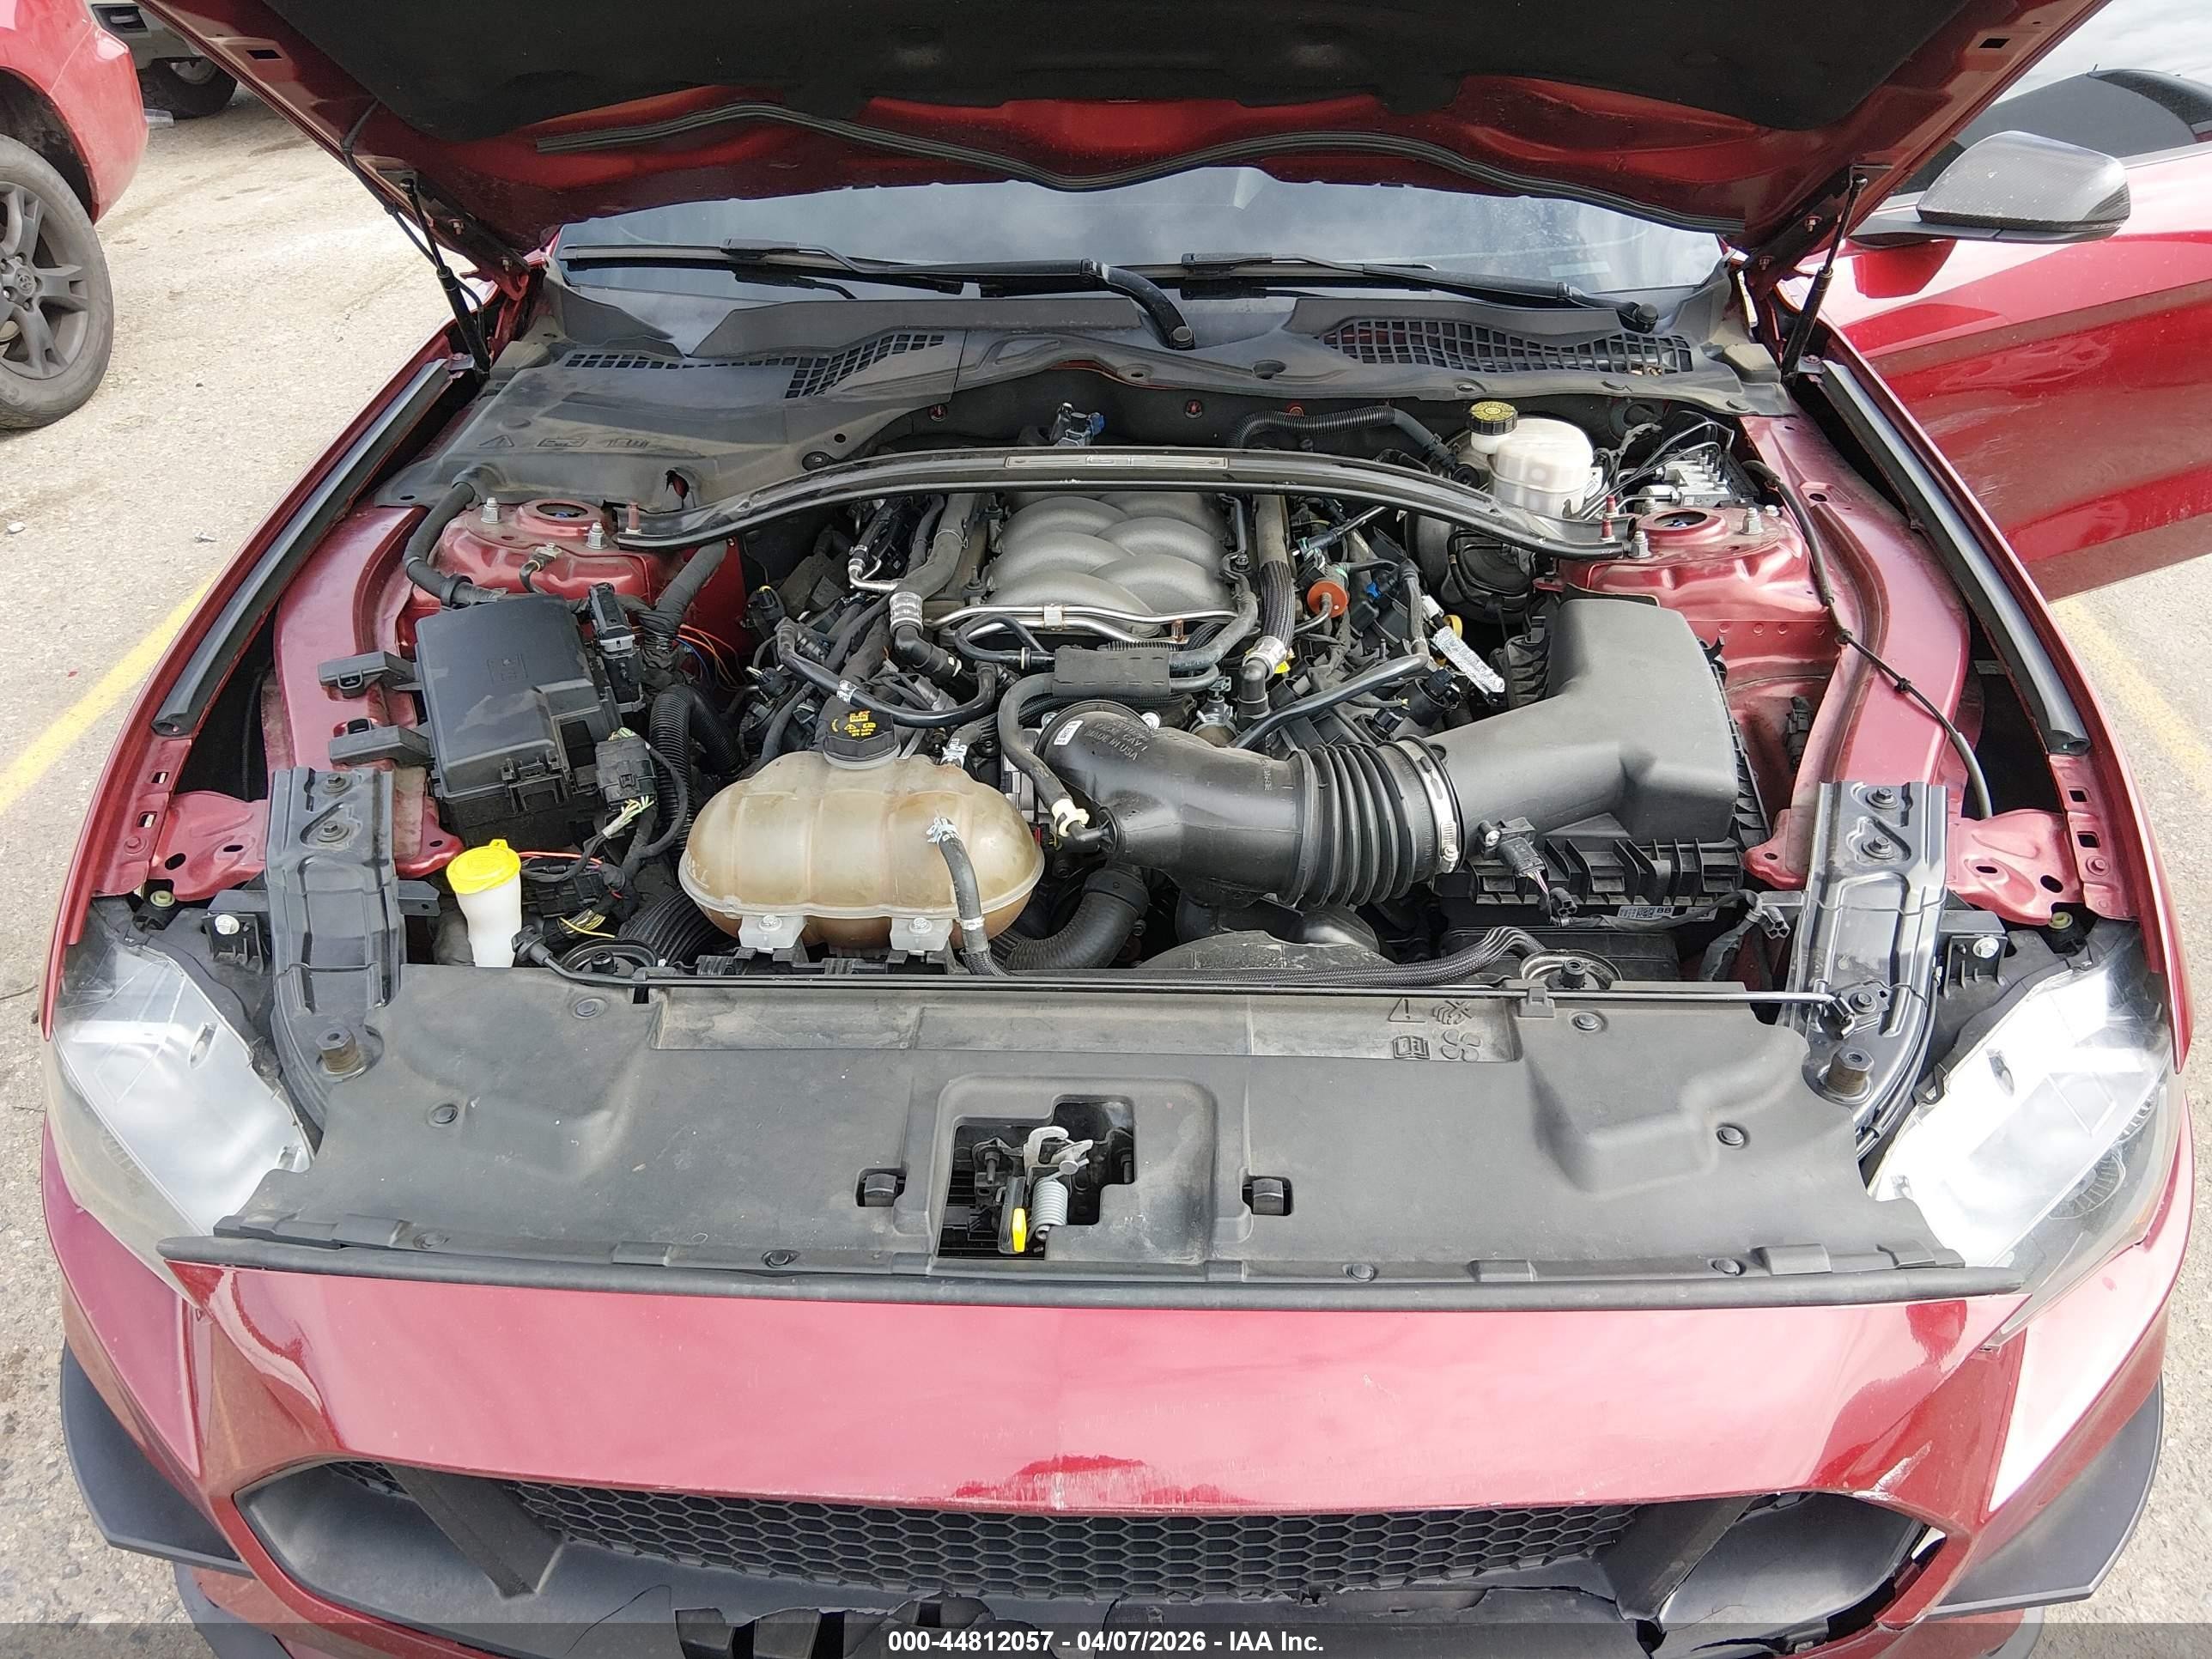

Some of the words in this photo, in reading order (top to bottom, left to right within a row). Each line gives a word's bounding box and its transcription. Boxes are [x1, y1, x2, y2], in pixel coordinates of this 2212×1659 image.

[1085, 729, 1109, 743] MADE
[1109, 738, 1121, 748] IN
[1119, 744, 1139, 761] USA
